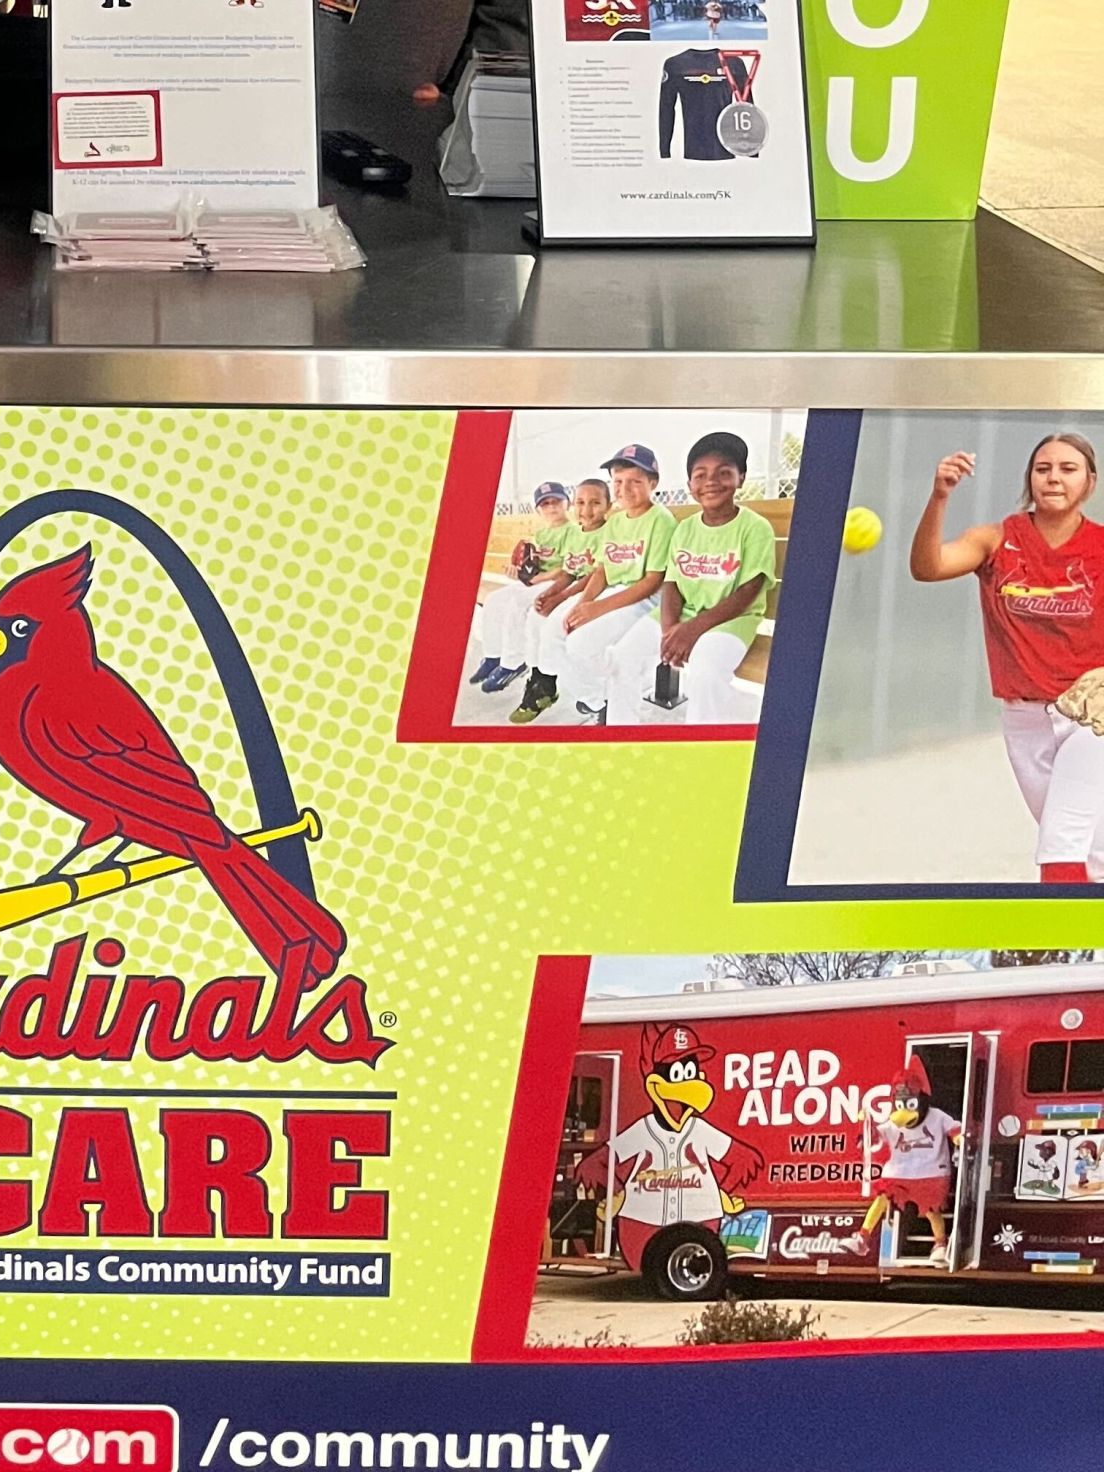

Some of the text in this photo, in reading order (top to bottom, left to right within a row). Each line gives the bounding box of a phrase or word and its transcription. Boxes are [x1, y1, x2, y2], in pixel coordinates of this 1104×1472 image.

[733, 111, 752, 131] 16
[620, 190, 732, 202] www.cardinals.com/5K
[723, 1049, 841, 1091] READ
[738, 1083, 893, 1127] ALONG
[789, 1133, 846, 1154] WITH
[768, 1163, 884, 1184] FREDBIRD
[801, 1215, 854, 1227] LET'S GO
[97, 1256, 292, 1292] Community
[300, 1257, 384, 1286] Fund
[198, 1417, 610, 1472] /community
